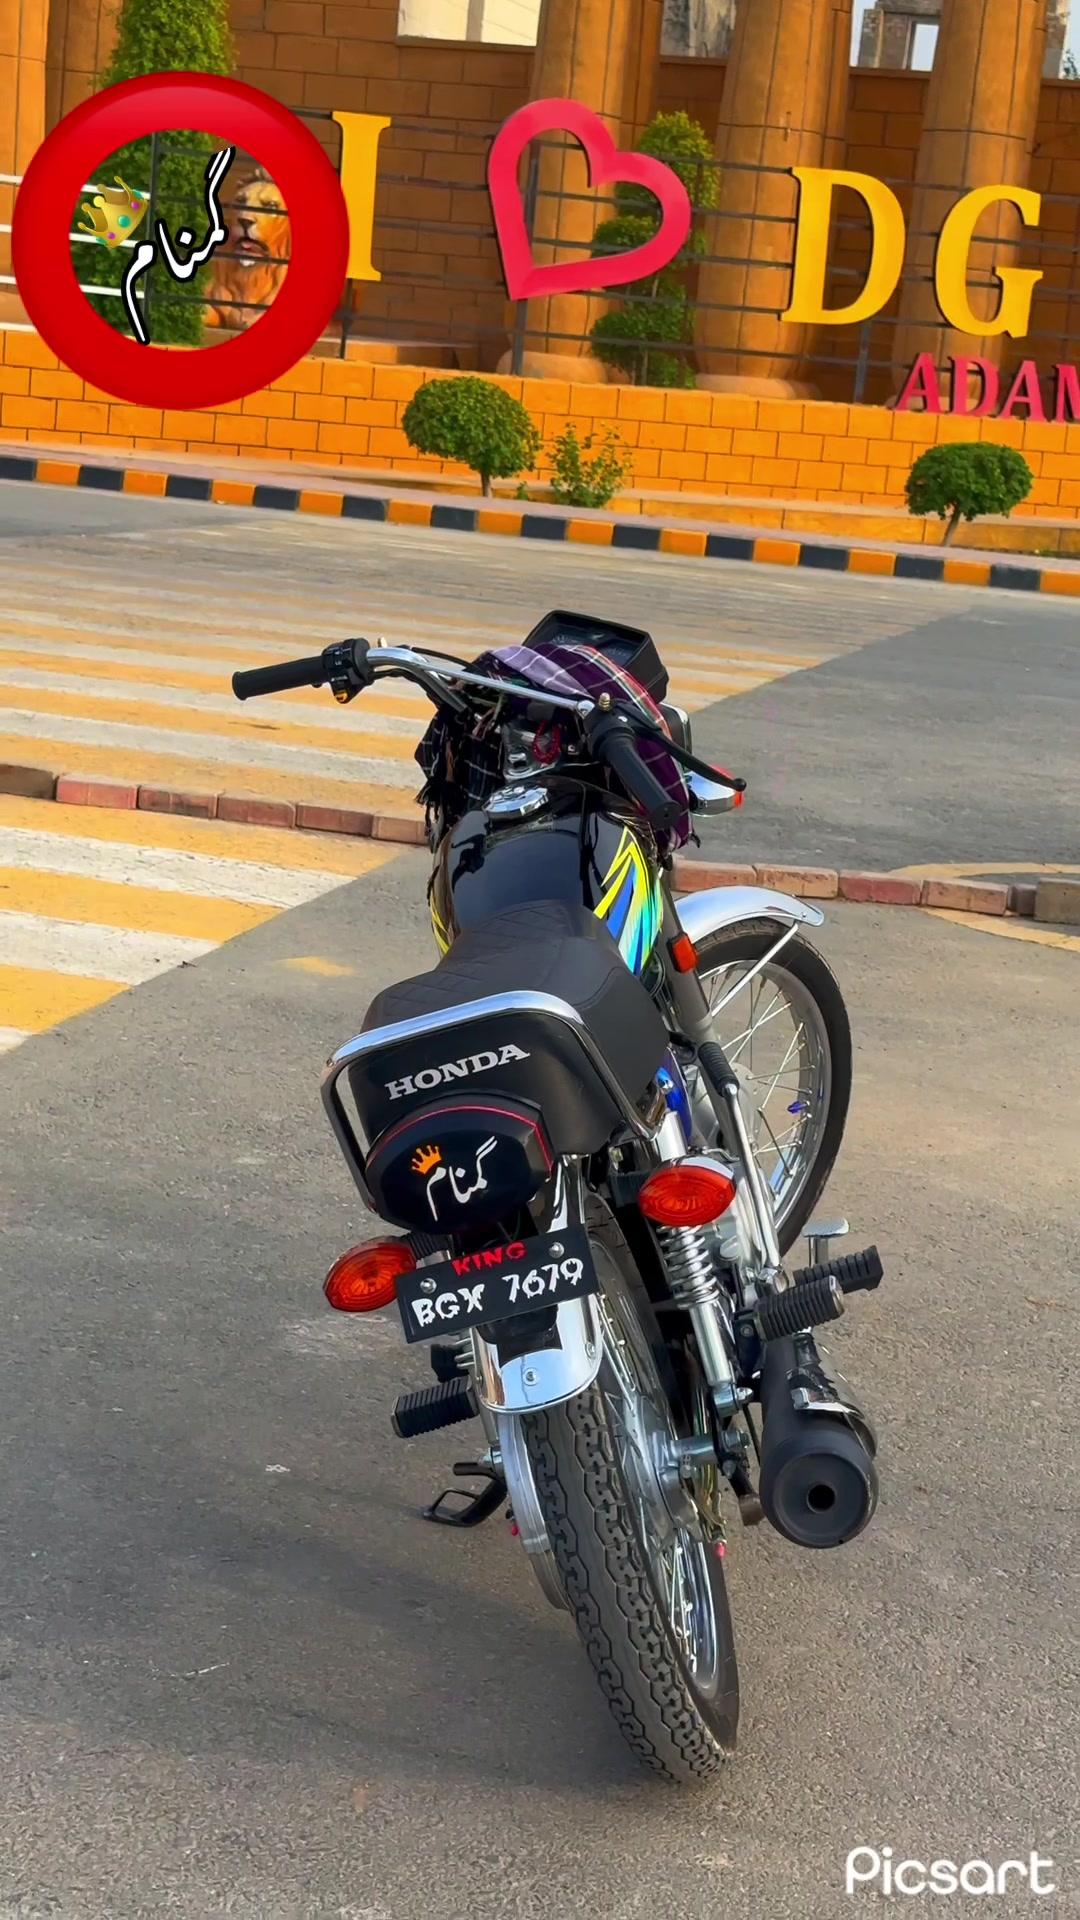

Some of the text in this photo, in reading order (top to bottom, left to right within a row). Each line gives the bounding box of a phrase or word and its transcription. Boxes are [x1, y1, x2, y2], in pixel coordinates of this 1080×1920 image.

[331, 110, 1045, 339] I DG
[384, 1043, 531, 1100] HONDA
[425, 1135, 499, 1222] گمنام
[411, 1257, 584, 1328] BGX 7679
[451, 1241, 527, 1276] KING
